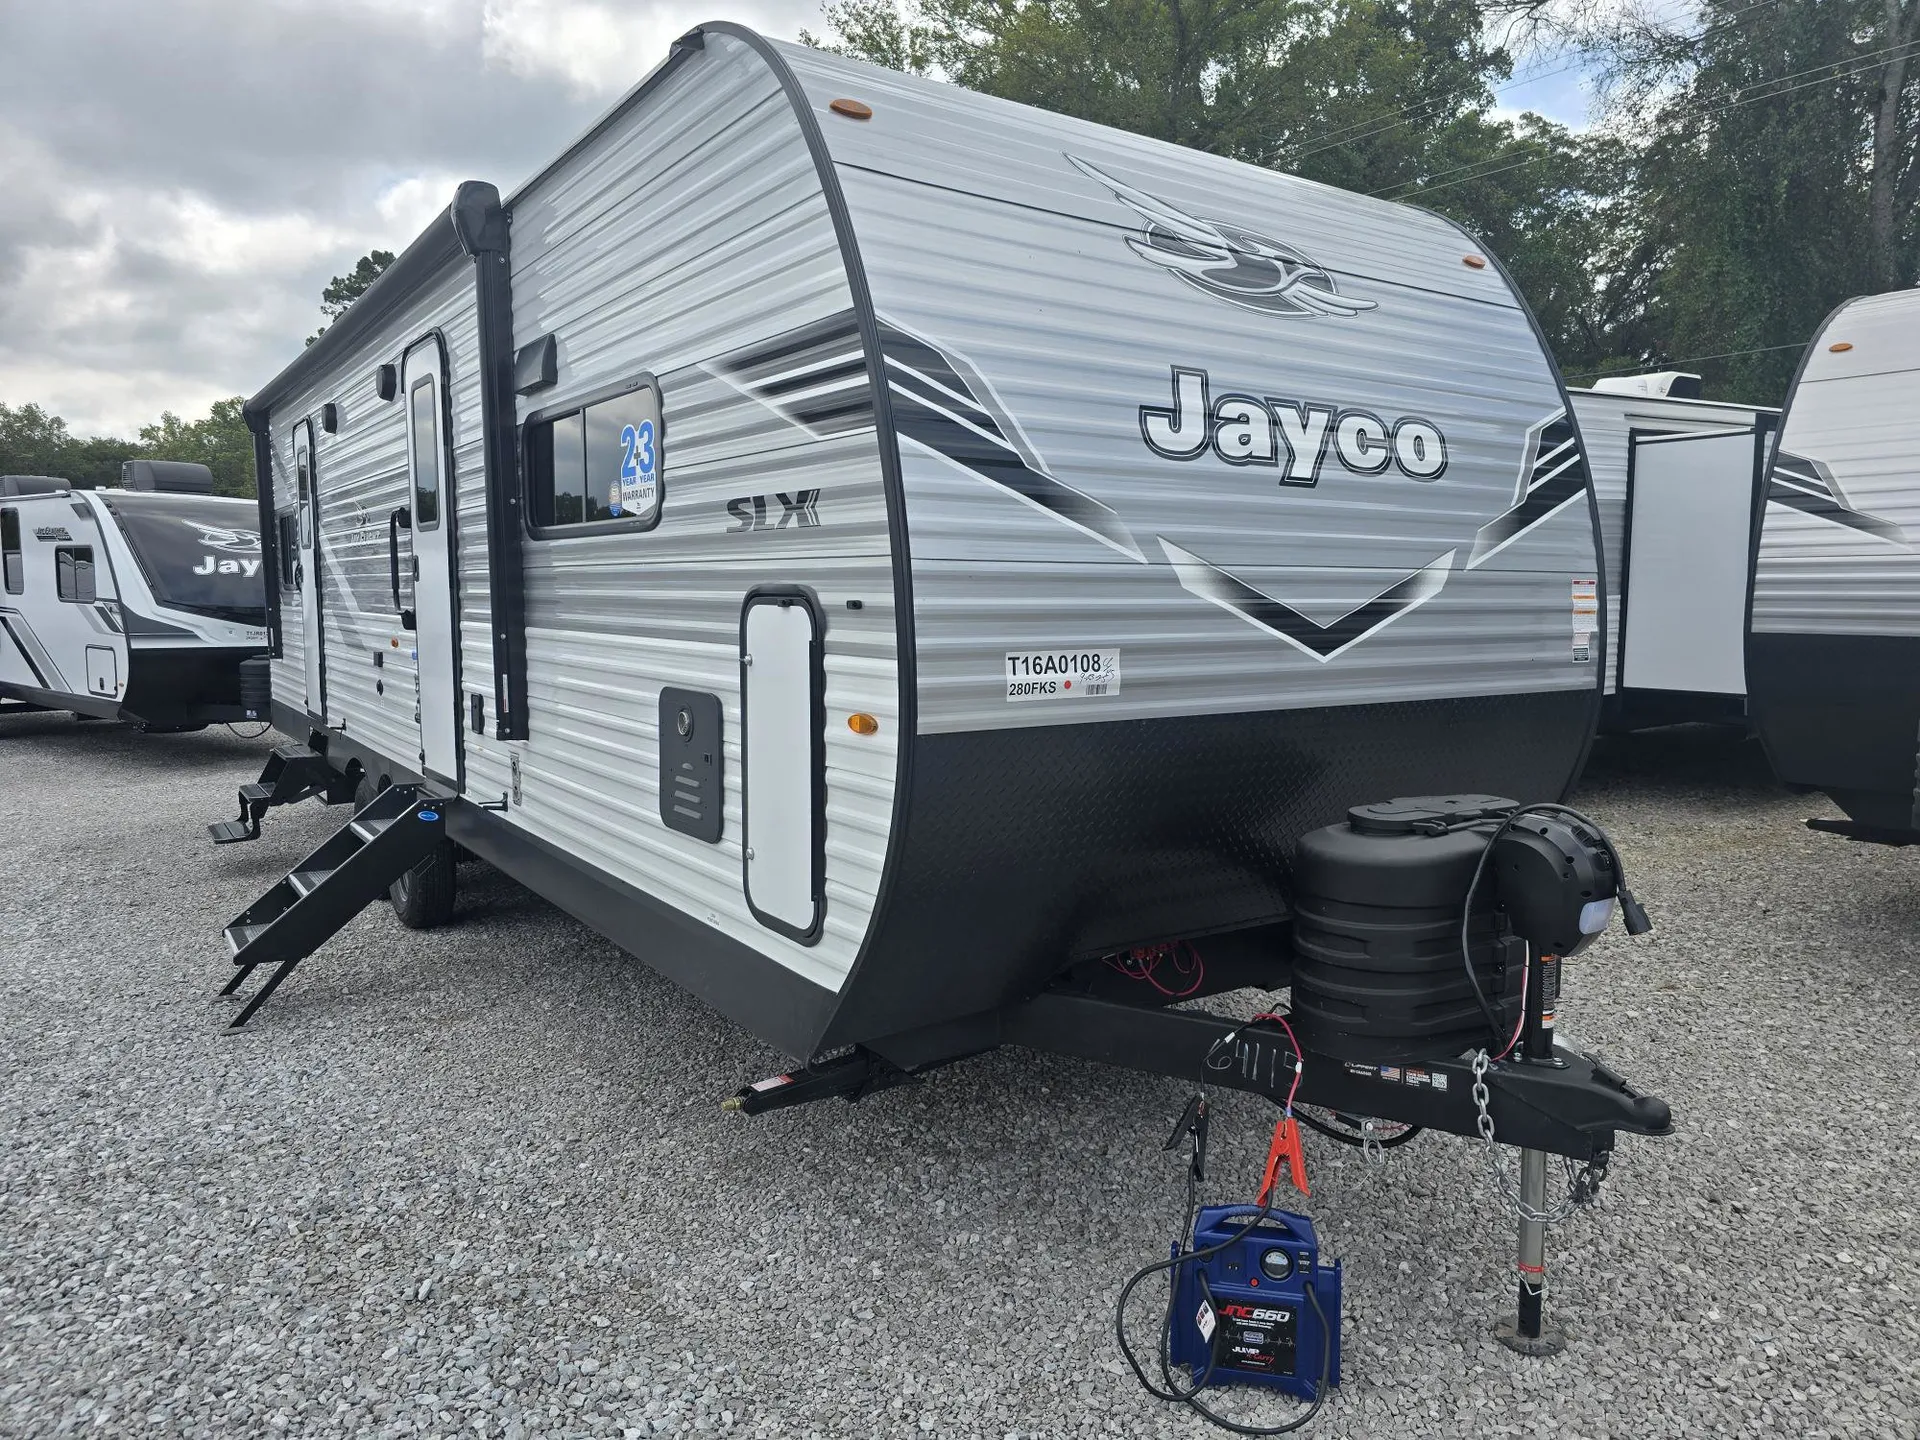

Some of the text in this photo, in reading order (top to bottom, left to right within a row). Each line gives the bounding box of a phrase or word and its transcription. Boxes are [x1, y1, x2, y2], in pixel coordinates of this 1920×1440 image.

[1138, 364, 1449, 488] Jayco
[639, 472, 655, 484] YEAR
[622, 486, 656, 502] WARRANTY
[725, 488, 822, 534] SLX
[1007, 653, 1101, 676] T16A0108
[1008, 681, 1057, 696] 280FKS
[1218, 1304, 1291, 1323] JNC660
